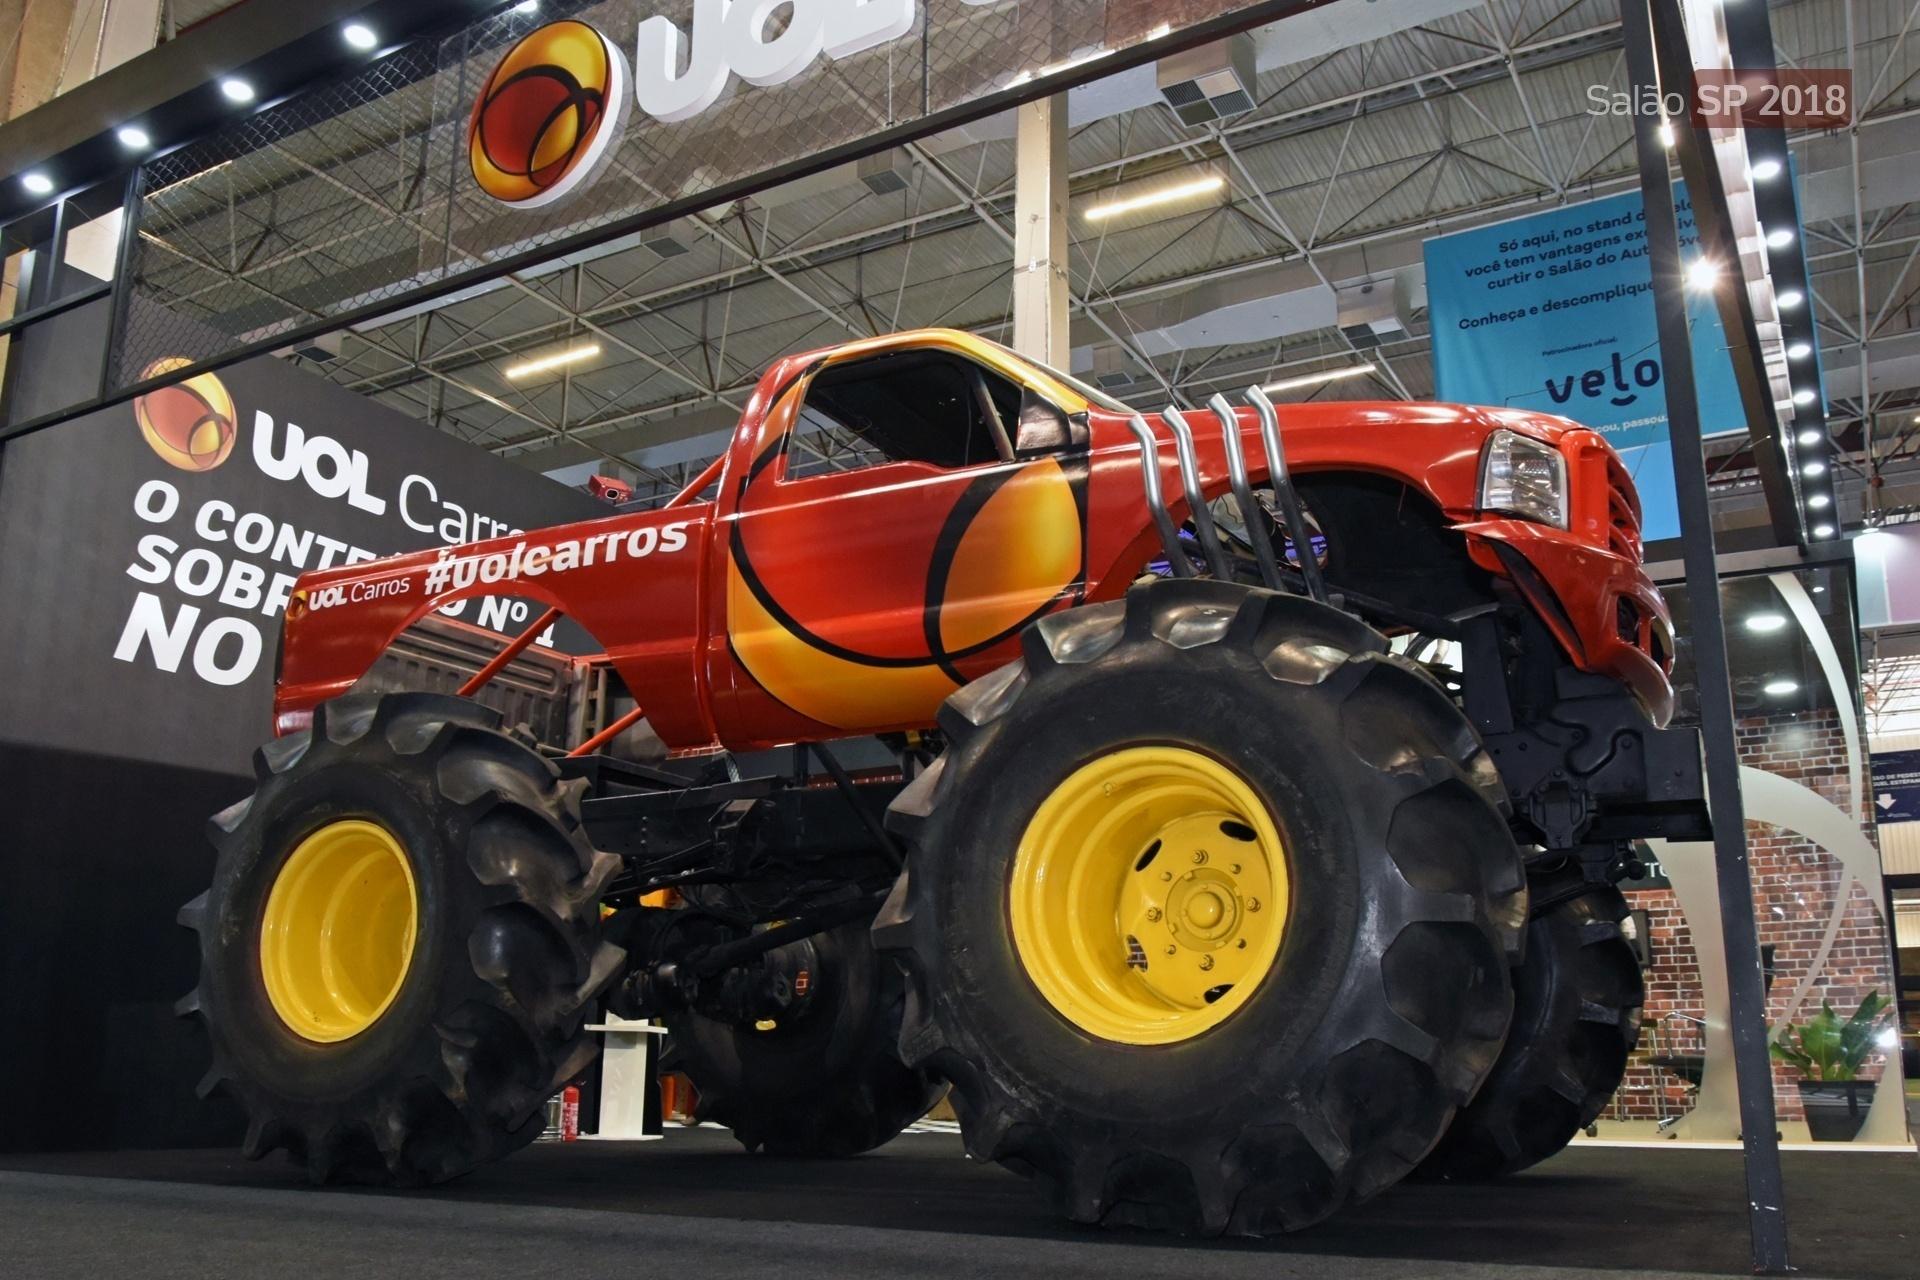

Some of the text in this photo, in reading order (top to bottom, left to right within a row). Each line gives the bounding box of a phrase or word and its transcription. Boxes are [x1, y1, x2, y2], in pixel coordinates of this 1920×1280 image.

[1499, 238, 1519, 254] Só
[1522, 230, 1560, 249] aqui,
[1563, 226, 1584, 238] no
[1586, 212, 1632, 233] stand
[1465, 234, 1621, 277] você tem vantagens
[1487, 271, 1531, 291] curtir
[1535, 269, 1545, 280] o
[1548, 254, 1593, 277] Salão
[1596, 249, 1617, 267] do
[1458, 302, 1526, 330] Conheça
[1529, 304, 1539, 316] e
[1592, 422, 1621, 435] cou,
[252, 409, 525, 546] UOL Carr
[134, 479, 180, 524] O
[126, 534, 297, 618] SOBR
[309, 520, 689, 611] UOL Carros #uolcarros
[113, 591, 263, 686] NO
